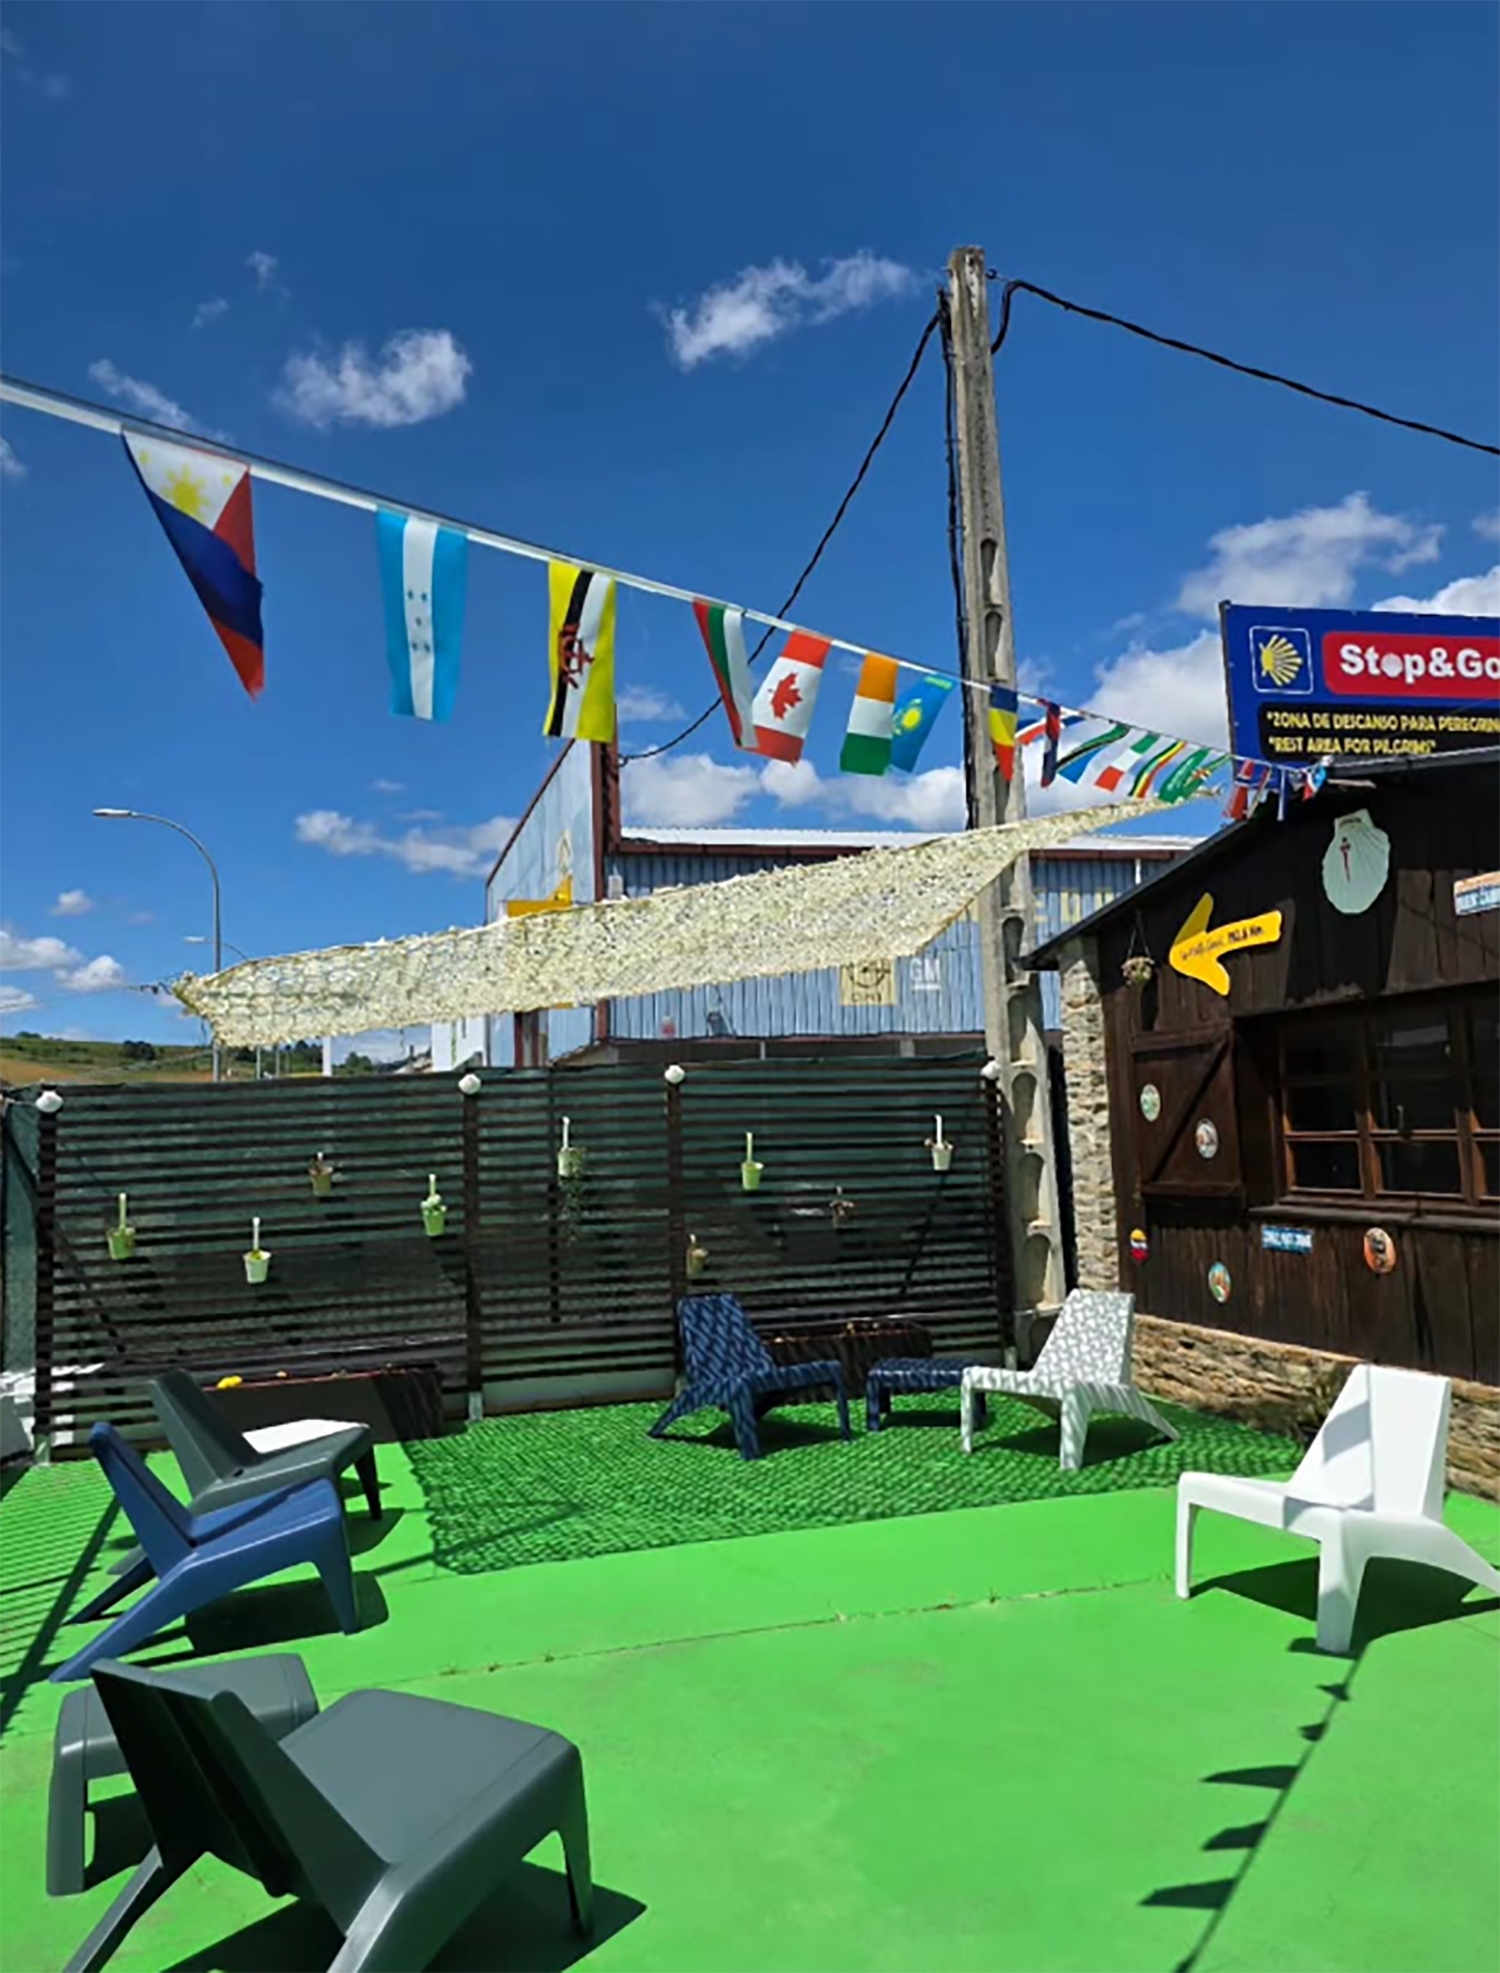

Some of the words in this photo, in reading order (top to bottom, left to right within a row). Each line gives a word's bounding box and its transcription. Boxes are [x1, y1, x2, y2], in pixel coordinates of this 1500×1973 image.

[1312, 712, 1331, 729] DE
[1332, 713, 1399, 731] DESCANSO
[1400, 714, 1436, 731] PARA
[1307, 736, 1342, 753] AREA
[1344, 737, 1371, 754] FOR
[909, 957, 941, 982] GM
